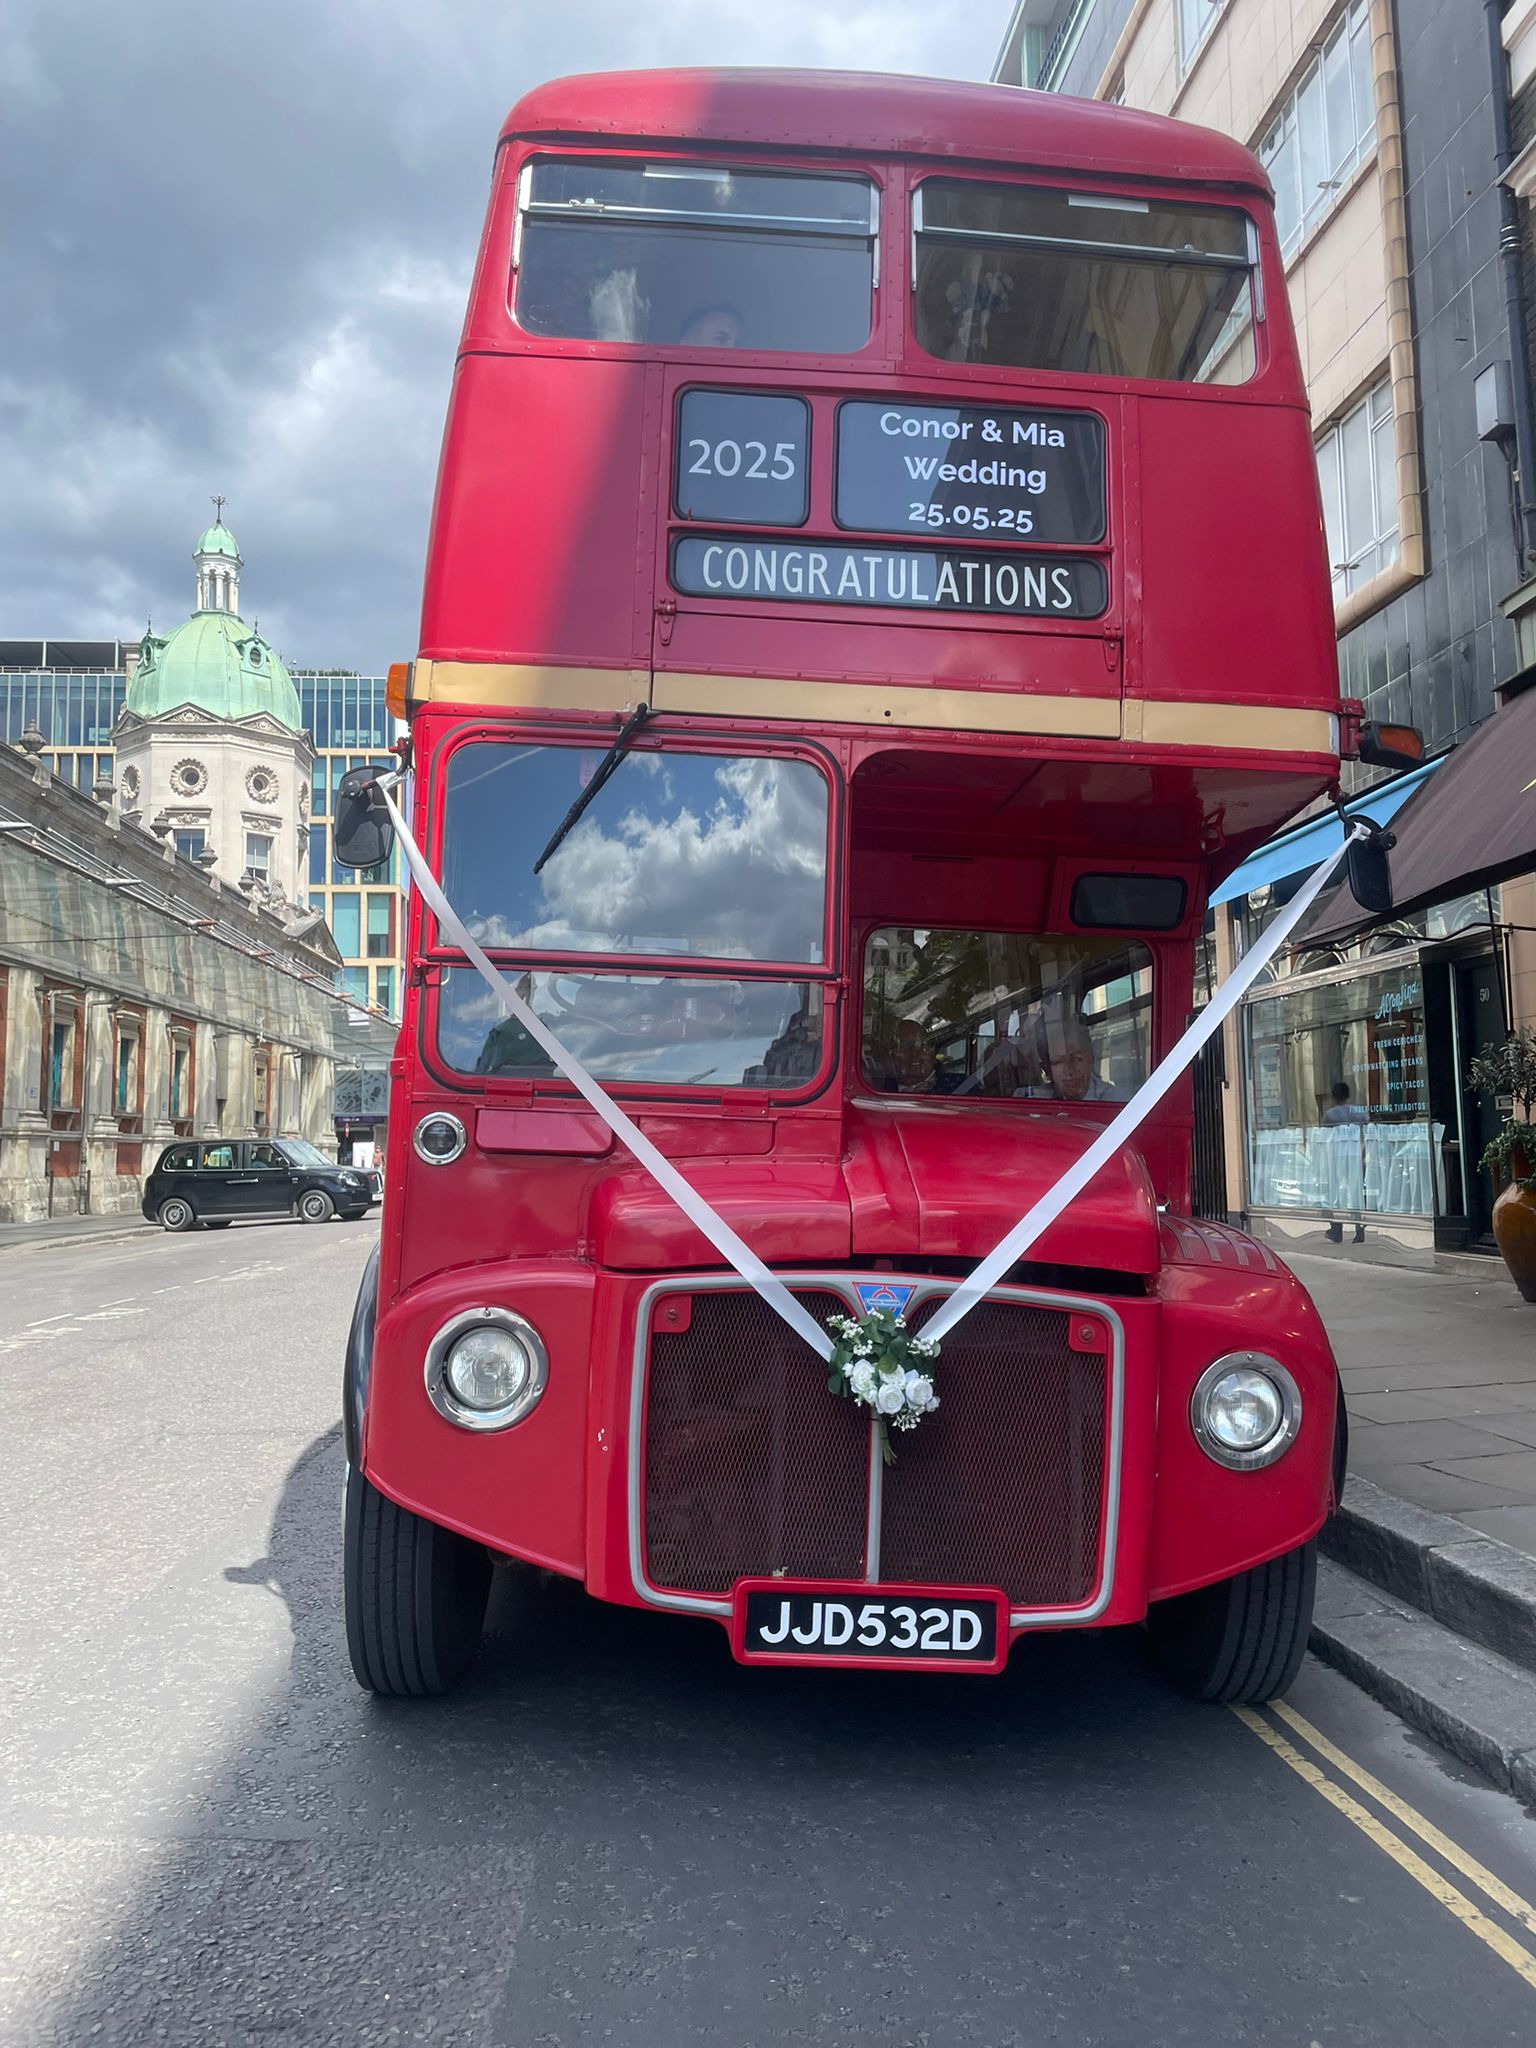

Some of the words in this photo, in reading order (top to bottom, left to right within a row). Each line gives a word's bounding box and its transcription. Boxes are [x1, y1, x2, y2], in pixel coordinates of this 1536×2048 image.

[879, 411, 974, 442] Conor
[981, 419, 1005, 444] &
[1011, 420, 1066, 448] Mia
[687, 438, 796, 481] 2025
[903, 455, 1047, 495] Wedding
[908, 501, 1035, 535] 25.05.25
[702, 546, 1073, 610] CONGRATULATIONS
[1479, 987, 1490, 1002] 50
[1373, 1039, 1392, 1049] FRESH
[1400, 1057, 1424, 1069] STEAKS
[1386, 1081, 1404, 1091] SPICY
[1405, 1079, 1425, 1089] TACOS
[1394, 1102, 1426, 1112] TIRADITOS
[758, 1601, 982, 1651] JJD532D
